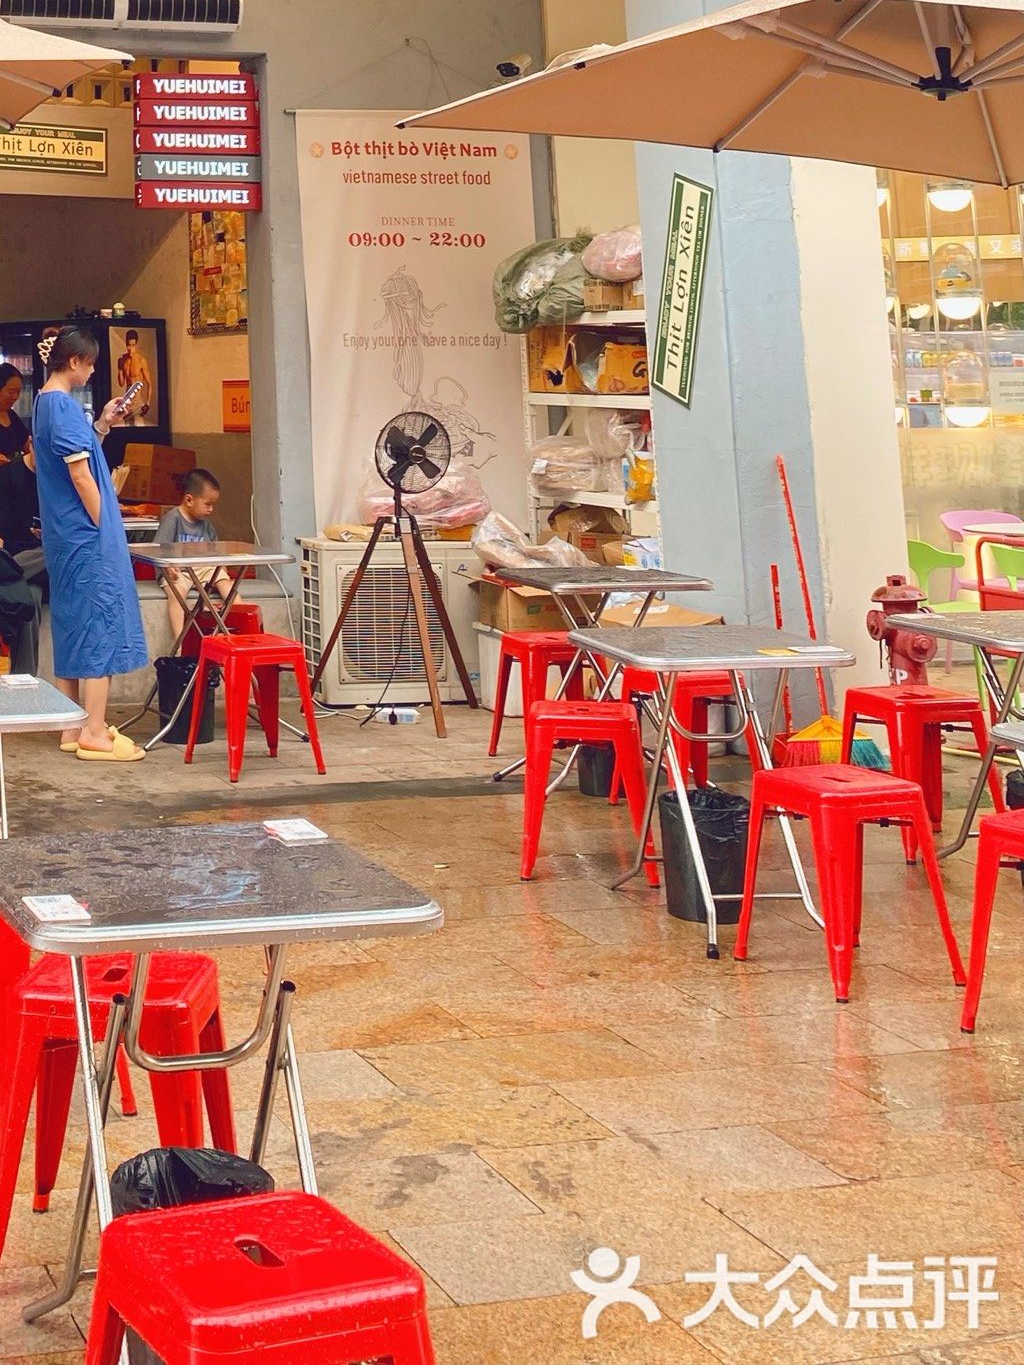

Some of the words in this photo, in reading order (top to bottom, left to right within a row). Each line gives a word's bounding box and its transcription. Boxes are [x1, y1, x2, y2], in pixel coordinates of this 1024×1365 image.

[153, 79, 246, 94] YUEHUIMEI
[153, 105, 247, 121] YUEHUIMEI
[62, 141, 94, 156] Xiên
[153, 133, 247, 148] YUEHUIMEI
[331, 140, 361, 159] Bột
[364, 141, 395, 160] thịt
[398, 140, 419, 156] bò
[423, 141, 456, 160] Việt
[460, 143, 497, 157] Nam
[154, 160, 249, 176] YUEHUIMEI
[343, 169, 417, 184] vietnamese
[420, 172, 459, 185] street
[462, 170, 491, 185] food
[154, 188, 250, 204] YUEHUIMEI
[381, 216, 424, 227] DINNER
[426, 217, 455, 227] TIME
[348, 232, 405, 247] 09:00
[429, 232, 486, 248] 22:00
[667, 325, 684, 370] Thịt
[679, 205, 695, 259] Xiên
[343, 334, 370, 350] Enjoy
[459, 334, 481, 347] nice
